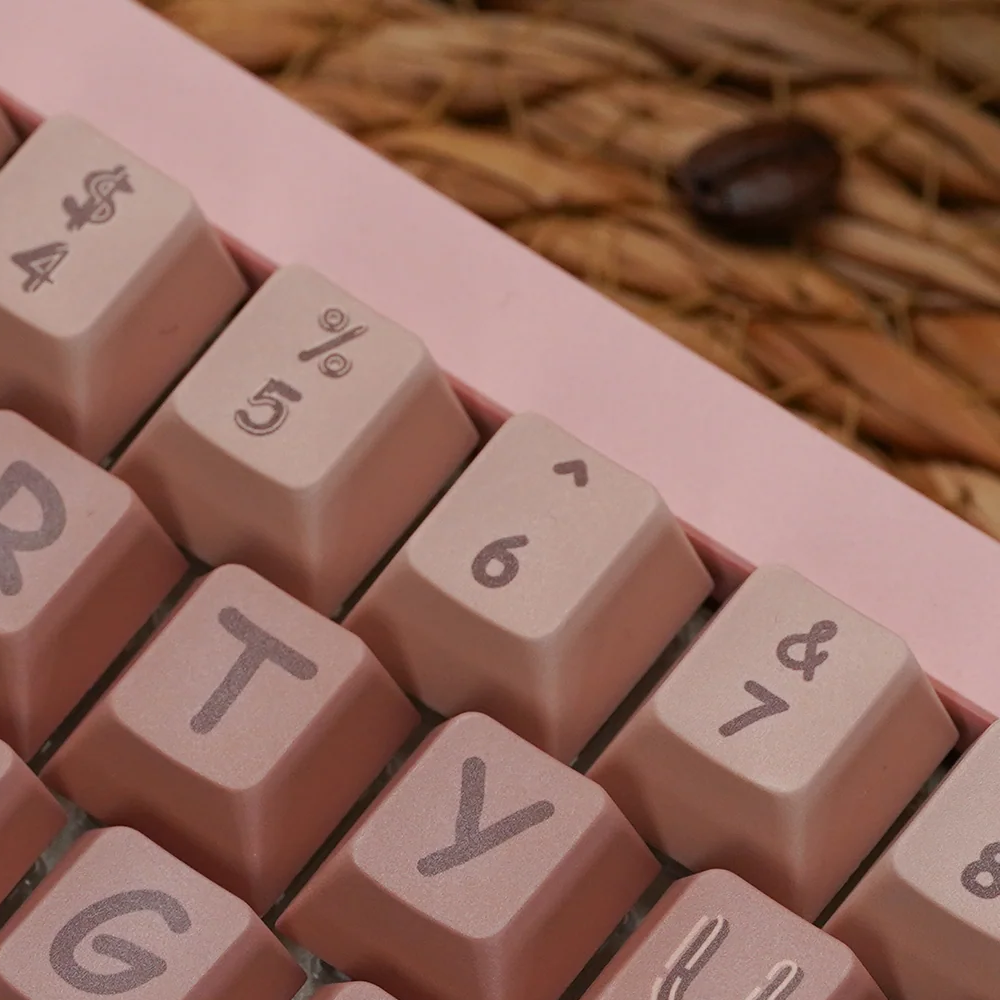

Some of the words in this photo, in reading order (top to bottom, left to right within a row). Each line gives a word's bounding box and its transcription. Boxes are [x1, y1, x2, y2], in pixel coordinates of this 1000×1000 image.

[61, 164, 136, 232] $
[11, 241, 69, 294] 4
[298, 307, 369, 379] %
[234, 377, 303, 437] 5
[471, 534, 530, 589] 6
[190, 606, 319, 736] T
[775, 619, 839, 682] &
[717, 679, 790, 738] 7
[416, 756, 555, 878] Y
[48, 889, 193, 995] G
